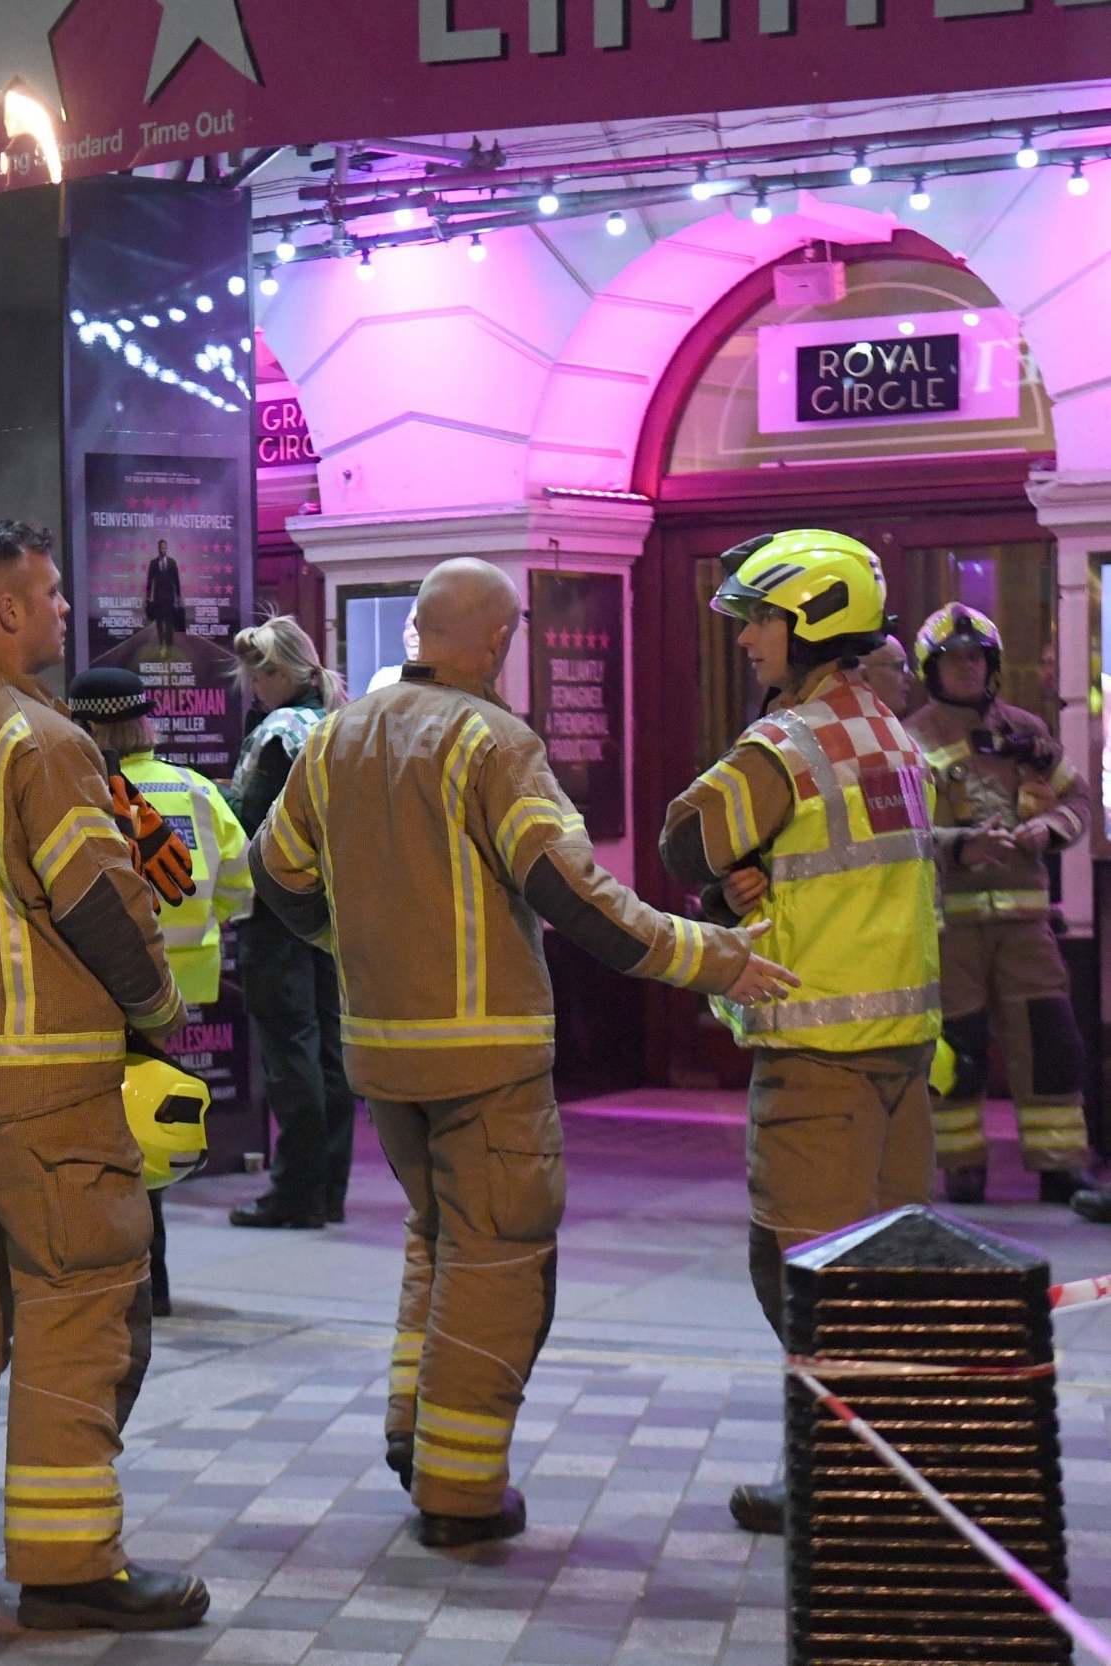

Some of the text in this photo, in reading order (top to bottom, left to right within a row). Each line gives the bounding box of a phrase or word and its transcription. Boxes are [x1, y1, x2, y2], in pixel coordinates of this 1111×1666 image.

[138, 121, 189, 147] Time
[195, 109, 234, 138] Out
[818, 342, 937, 379] ROYAL
[810, 377, 945, 415] CIRCLE
[153, 688, 226, 716] SALESMAN
[172, 716, 206, 731] MILLER
